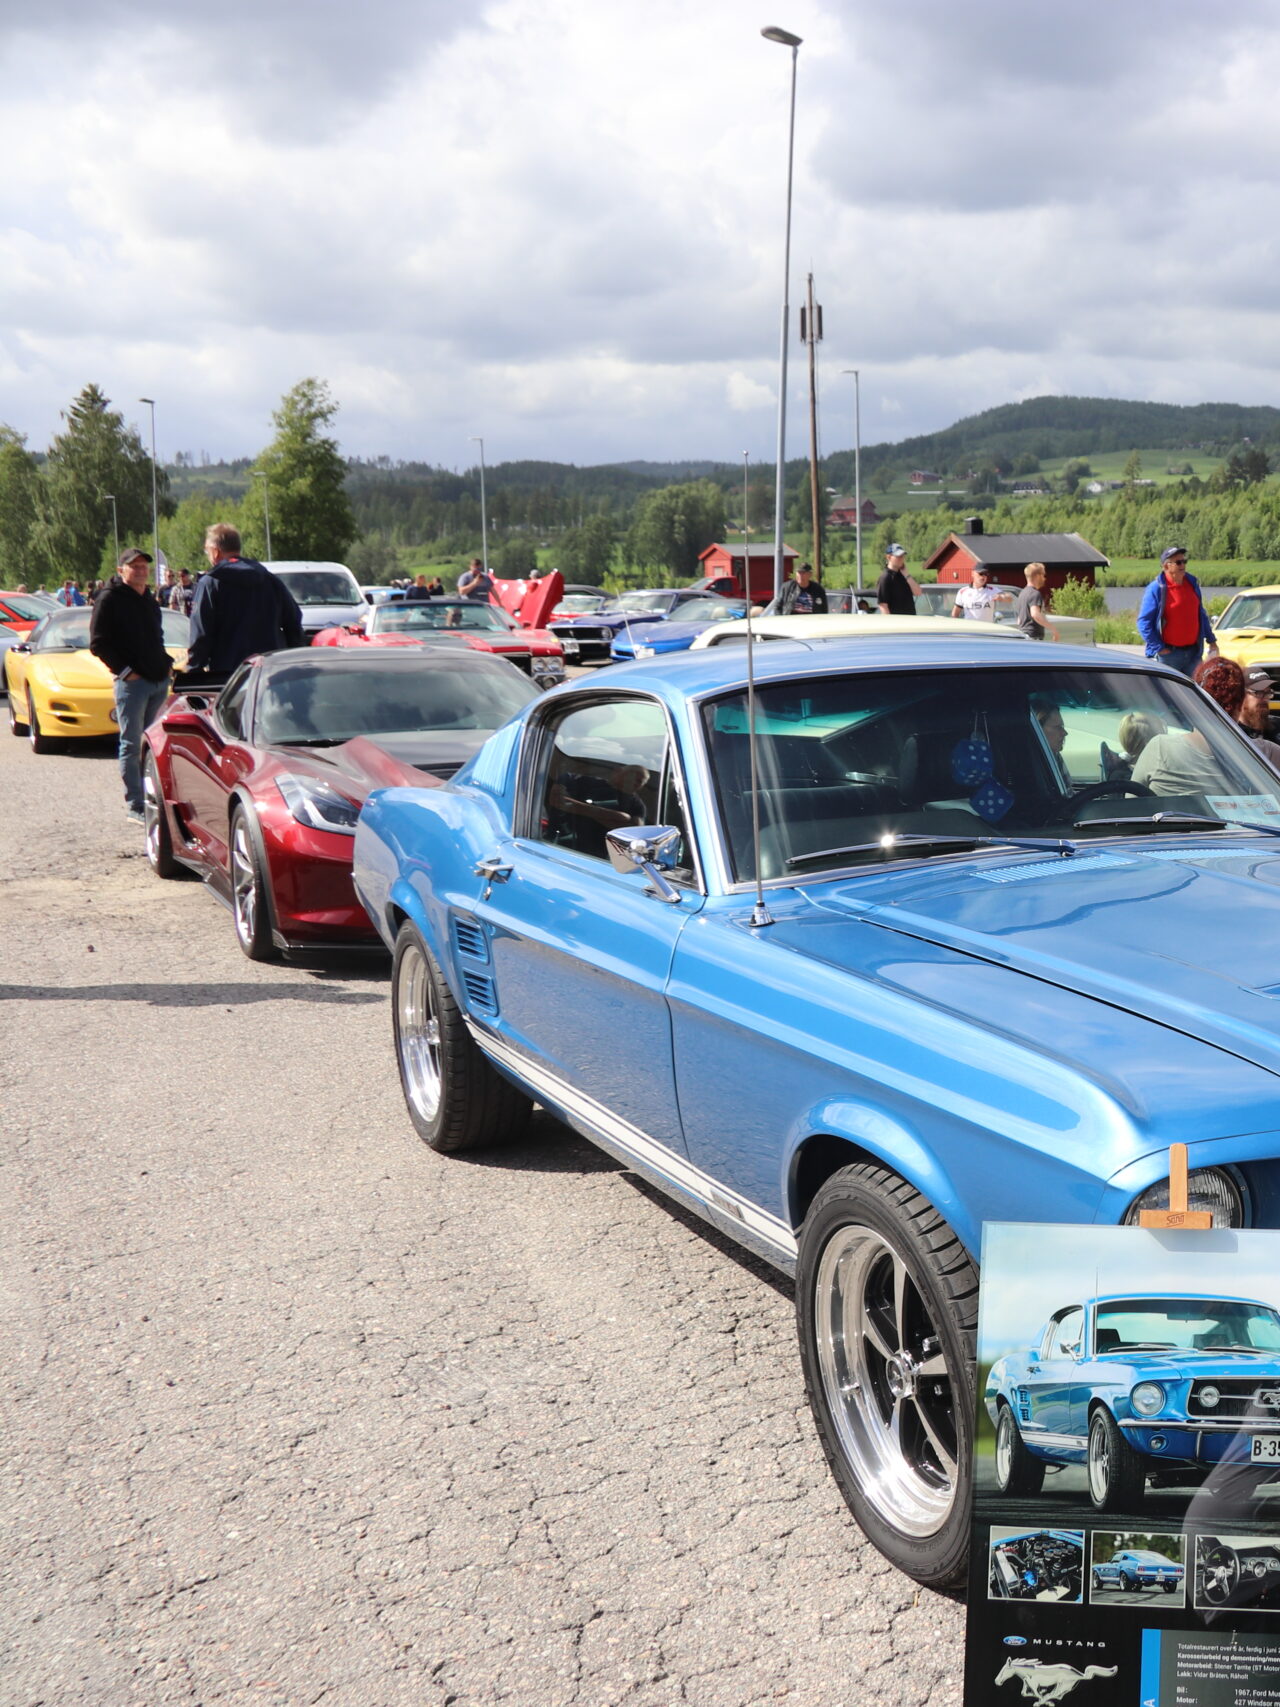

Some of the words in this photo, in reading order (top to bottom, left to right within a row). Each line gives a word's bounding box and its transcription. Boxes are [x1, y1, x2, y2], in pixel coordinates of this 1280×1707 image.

[1033, 1638, 1106, 1648] MUSTANG
[1178, 1643, 1219, 1651] Totalrestaurert
[1246, 1645, 1262, 1654] ferdig
[1177, 1652, 1222, 1660] Karosseriarbeid
[1177, 1661, 1214, 1669] Motorarbeid:
[1235, 1688, 1252, 1697] 1967,
[1252, 1689, 1267, 1697] Ford
[1234, 1698, 1246, 1706] 427
[1247, 1699, 1273, 1707] Windsor
